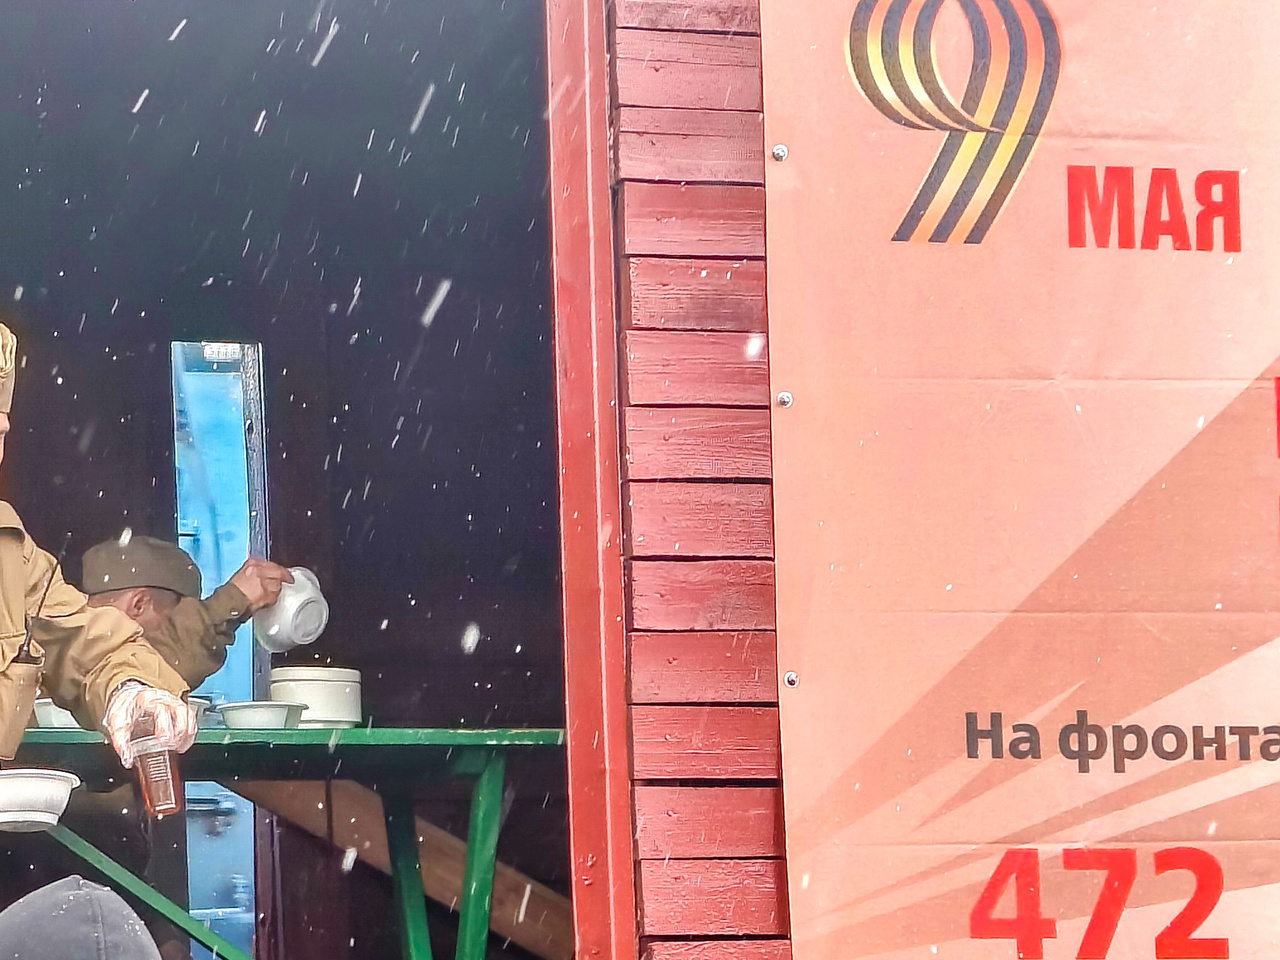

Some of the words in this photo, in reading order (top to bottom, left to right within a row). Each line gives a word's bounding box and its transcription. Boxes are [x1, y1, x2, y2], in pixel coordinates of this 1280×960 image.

[1066, 165, 1242, 253] МАЯ
[965, 712, 1041, 760] На
[969, 846, 1230, 960] 472
